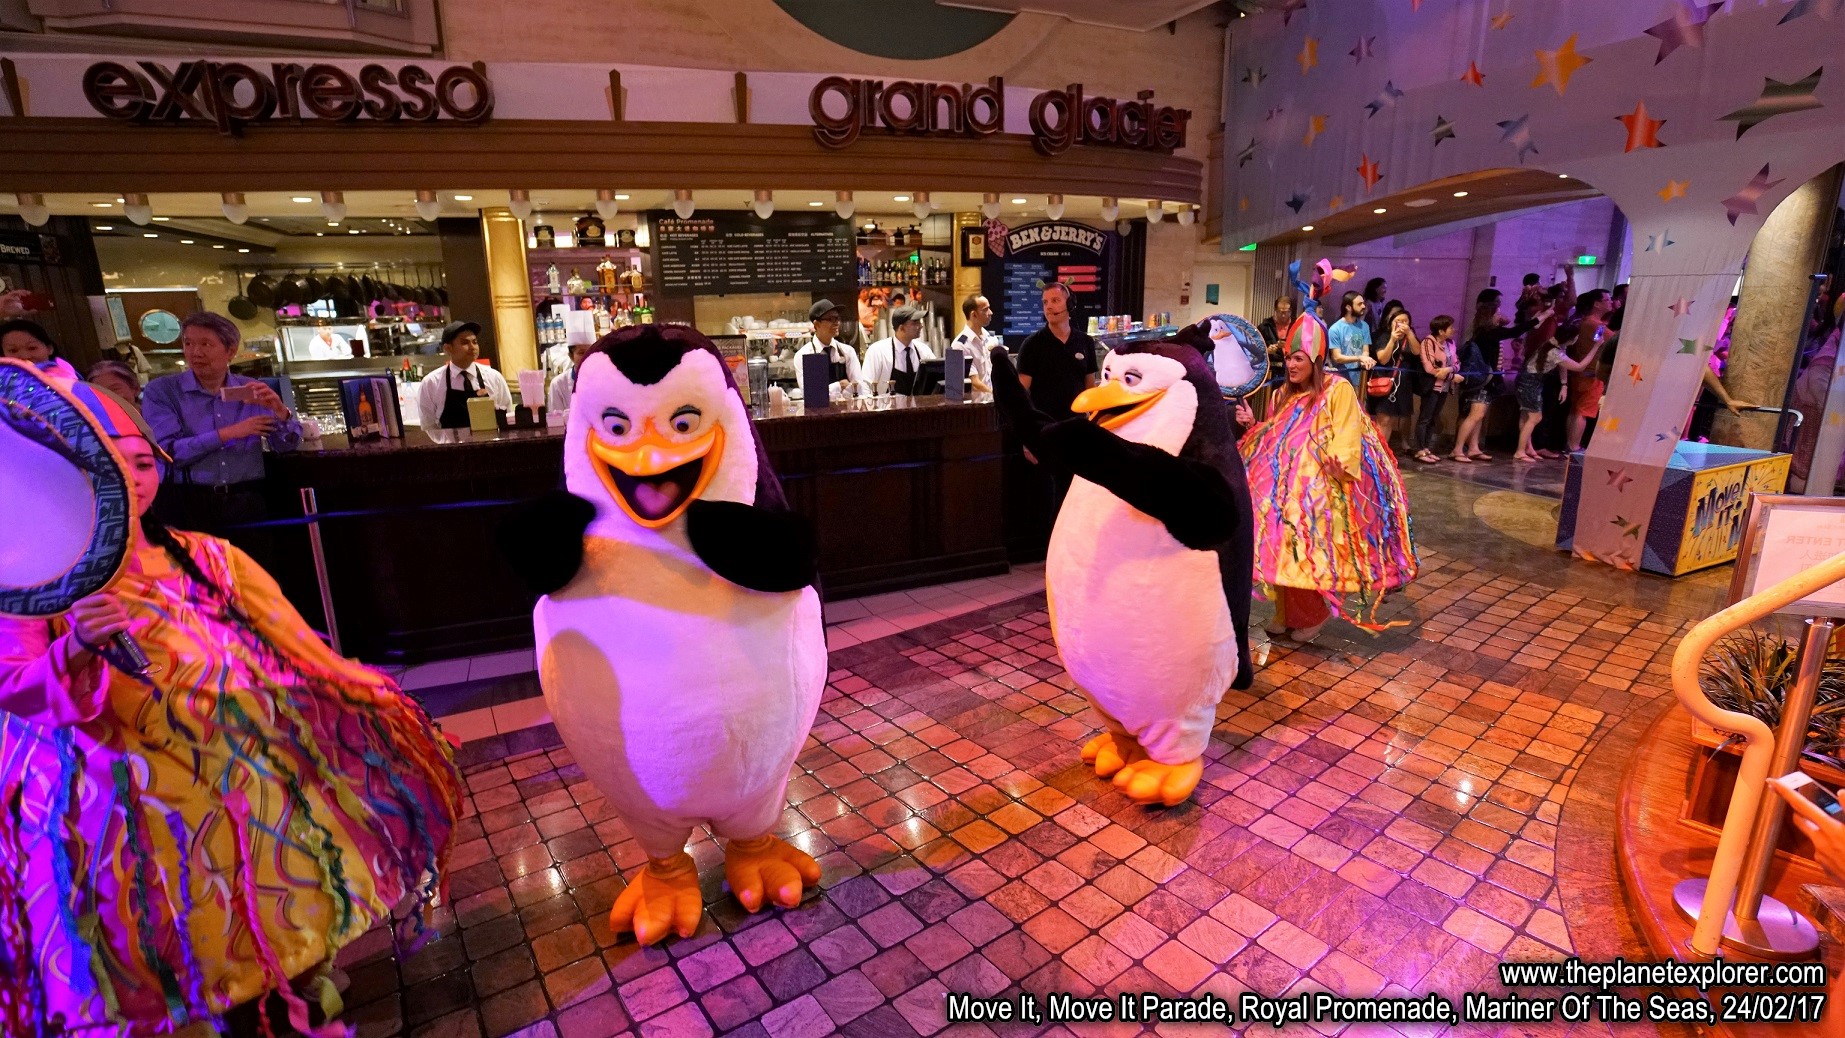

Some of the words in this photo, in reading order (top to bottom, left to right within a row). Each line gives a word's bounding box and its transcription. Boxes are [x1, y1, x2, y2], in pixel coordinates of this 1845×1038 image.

[82, 60, 494, 137] expresso
[809, 76, 1004, 149] grand
[1029, 83, 1192, 156] glacier
